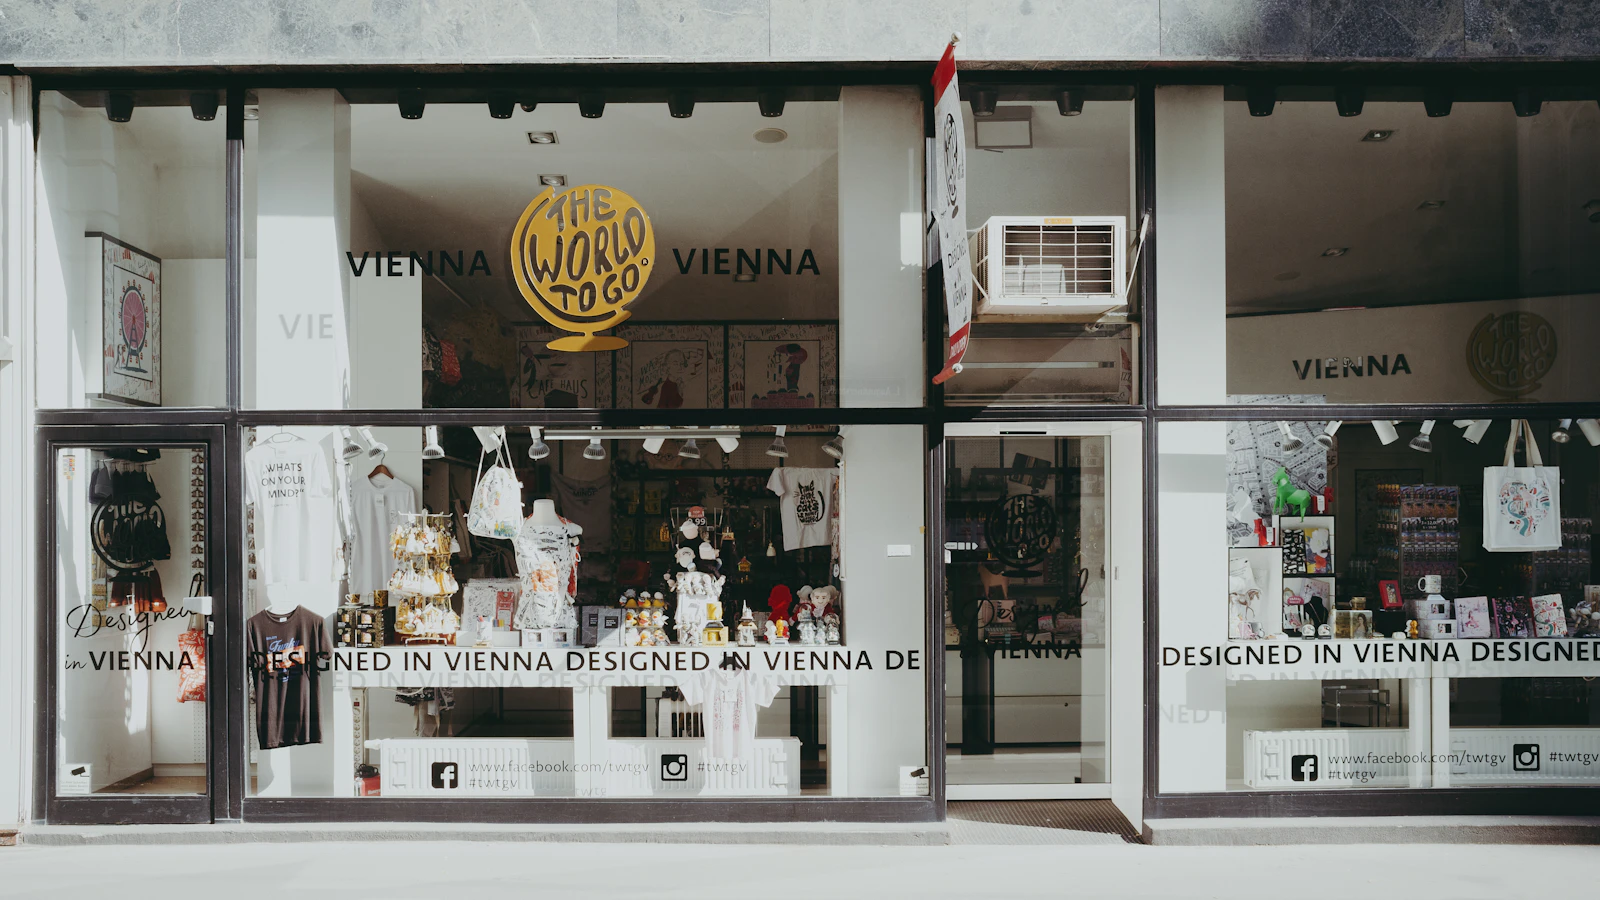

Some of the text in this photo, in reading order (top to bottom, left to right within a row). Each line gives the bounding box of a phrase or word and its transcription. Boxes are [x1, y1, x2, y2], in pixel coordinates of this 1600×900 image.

[546, 188, 617, 232] THE
[529, 206, 646, 284] WORLD
[346, 250, 492, 277] VIENNA
[672, 248, 821, 275] VIENNA
[549, 263, 640, 312] TO GO
[1488, 314, 1532, 339] THE
[1478, 324, 1550, 369] WORLD
[1292, 354, 1412, 381] VIENNA
[560, 379, 589, 400] HAUS
[261, 475, 306, 487] ON YOUR
[65, 651, 195, 671] in VIENNA
[250, 651, 391, 671] DESIGNED
[404, 651, 431, 671] IN
[444, 651, 553, 671] VIENNA
[566, 651, 710, 671] DESIGNED
[724, 651, 751, 671] IN
[764, 650, 874, 671] VIENNA
[885, 650, 921, 670] DE
[1162, 645, 1303, 667] DESIGNED
[1314, 643, 1342, 664] IN
[1355, 642, 1460, 664] VIENNA
[468, 759, 650, 775] www.facebook.com/twtgv
[697, 760, 747, 776] #twtgv
[1328, 751, 1507, 767] www.facebook.com/twtgv
[1548, 751, 1600, 765] #twtgv
[468, 777, 518, 791] #twtgv
[1328, 769, 1377, 783] #twtgv
